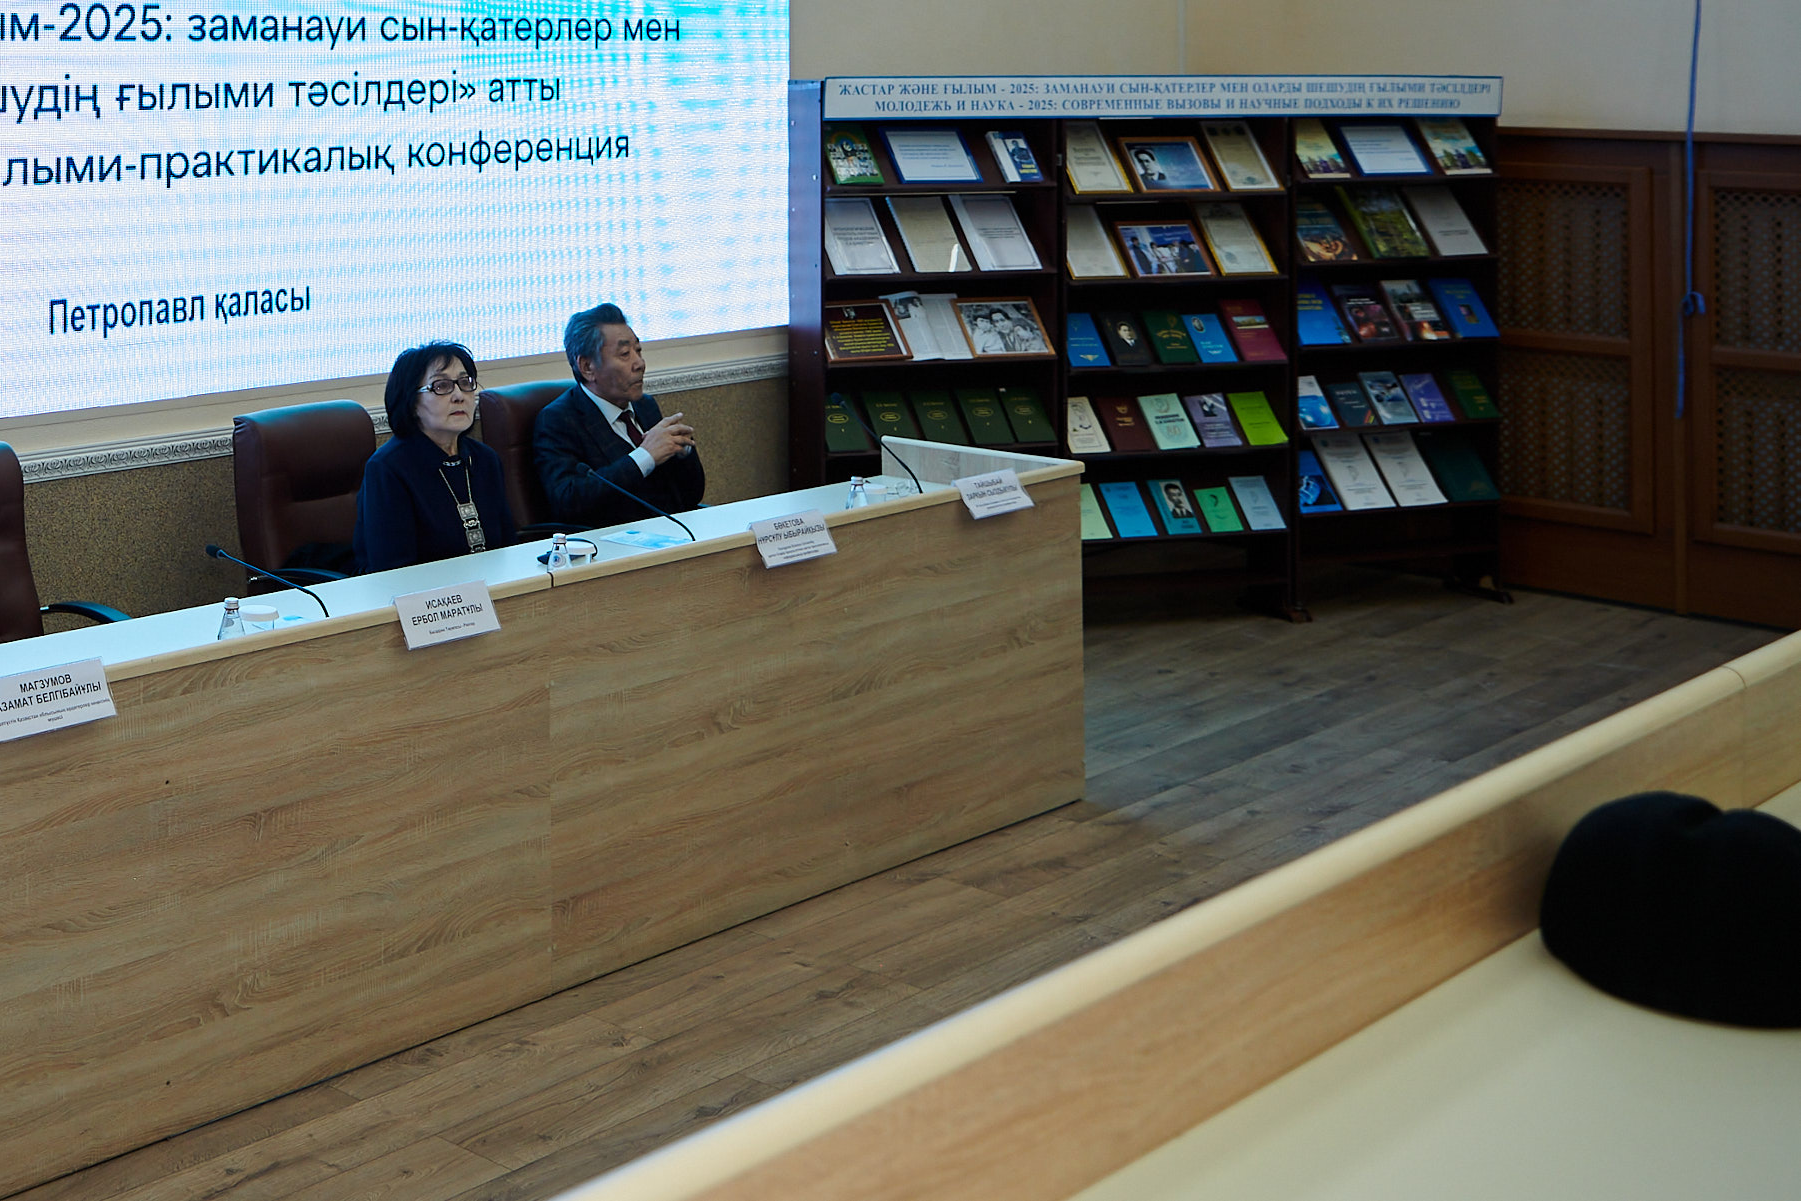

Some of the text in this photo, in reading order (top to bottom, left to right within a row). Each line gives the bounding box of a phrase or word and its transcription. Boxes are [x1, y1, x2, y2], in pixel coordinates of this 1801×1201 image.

[187, 11, 367, 51] заманауи
[380, 13, 613, 50] сын-қатерлер
[623, 17, 681, 43] мен
[115, 80, 275, 114] ғылыми
[287, 70, 476, 113] тәсілдері»
[488, 73, 561, 103] атты
[839, 83, 895, 96] ЖАСТАР
[899, 83, 939, 96] ЖӘНЕ
[943, 83, 997, 96] ҒЫЛЫМ
[1010, 83, 1039, 96] 2025:
[1042, 82, 1116, 95] ЗАМАНАУИ
[1220, 82, 1249, 94] МЕН
[1252, 82, 1301, 95] ОЛАРДЫ
[874, 100, 951, 112] МОЛОДЕЖЬ
[956, 100, 966, 111] И
[971, 99, 1015, 111] НАУКА
[1028, 99, 1058, 111] 2025:
[1061, 98, 1163, 111] СОВРЕМЕННЫЕ
[1166, 98, 1220, 110] ВЫЗОВЫ
[1226, 98, 1235, 110] И
[1239, 98, 1299, 110] НАУЧНЫЕ
[1304, 98, 1362, 111] ПОДХОДЫ
[1378, 98, 1393, 109] ИХ
[1398, 97, 1461, 110] РЕШЕНИЮ
[407, 129, 630, 172] конференция
[49, 283, 312, 339] Петропавл қаласы
[425, 594, 463, 610] ИСАҚАЕВ
[411, 603, 483, 626] ЕРБОЛ МАРАТҰЛЫ
[19, 673, 72, 693] МАГЗУМОВ
[36, 681, 102, 704] БЕЛГІБАЙҰЛЫ
